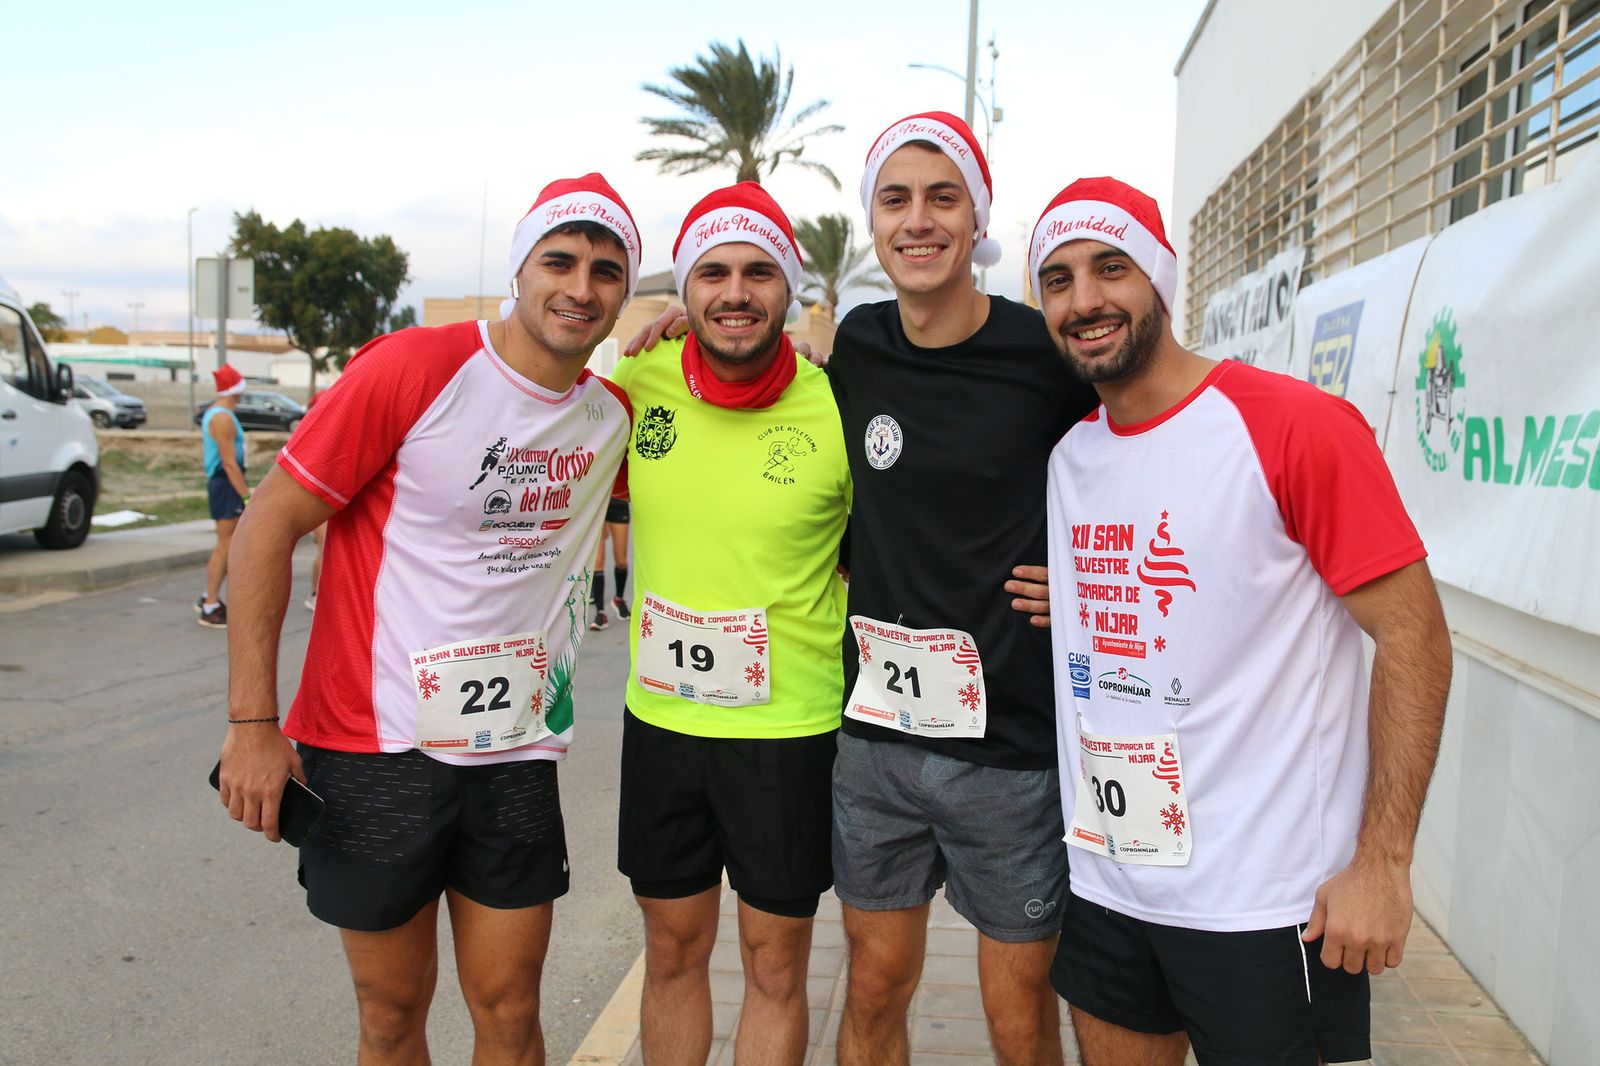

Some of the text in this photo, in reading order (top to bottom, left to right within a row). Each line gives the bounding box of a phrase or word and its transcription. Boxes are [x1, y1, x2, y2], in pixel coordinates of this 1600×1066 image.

[899, 122, 970, 160] Navidad
[731, 213, 790, 260] Navidad
[1046, 216, 1129, 240] Navidad
[757, 428, 773, 440] CLUB
[787, 426, 817, 453] ATLETISMO
[890, 423, 900, 442] CLUB
[498, 464, 547, 477] PAUNIC
[547, 446, 595, 482] Cortijo
[520, 484, 571, 513] del Fraile
[1072, 524, 1134, 551] XII SAN
[1074, 556, 1129, 575] SILVESTRE
[1077, 581, 1141, 604] COMARCA DE
[645, 597, 653, 606] XII
[653, 600, 665, 613] SAN
[666, 606, 705, 625] SILVESTRE
[708, 615, 737, 623] COMARCA
[1095, 607, 1138, 636] NÍJAR
[854, 621, 864, 630] XII
[865, 624, 876, 634] SAN
[877, 627, 911, 643] SILVESTRE
[912, 634, 945, 642] COMARCA
[414, 657, 427, 665] XII
[430, 650, 451, 663] SAN
[453, 643, 501, 658] SILVESTRE
[504, 639, 528, 649] COMARCA
[668, 639, 714, 672] 19
[1068, 652, 1090, 665] CUCN
[883, 660, 921, 699] 21
[1098, 680, 1151, 698] COPROHNÍJAR
[460, 676, 511, 716] 22
[1146, 742, 1155, 750] DE
[1091, 775, 1126, 817] 30
